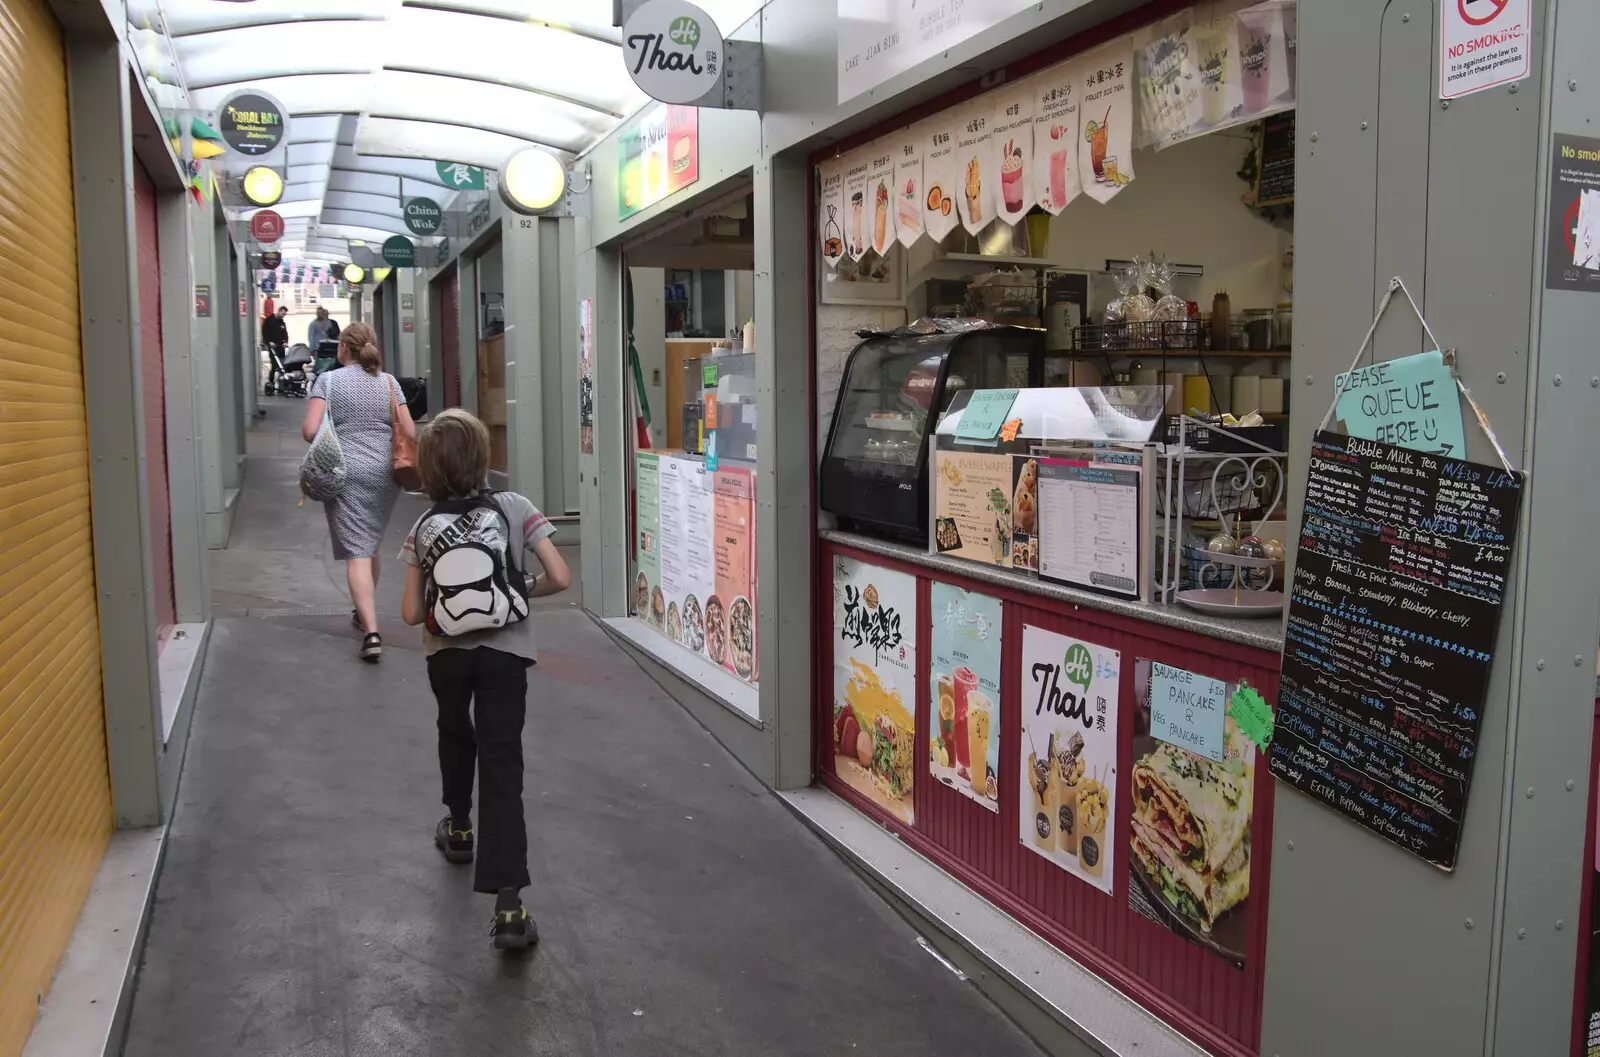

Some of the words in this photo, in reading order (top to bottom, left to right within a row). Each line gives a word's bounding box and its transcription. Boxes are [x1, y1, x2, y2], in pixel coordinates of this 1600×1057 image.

[918, 4, 946, 30] BUBBLE
[670, 20, 697, 44] Hi
[628, 33, 703, 75] Thai
[845, 54, 860, 72] CAKE
[865, 44, 881, 61] JIAN
[883, 31, 900, 50] BING
[1243, 49, 1268, 67] shmoo
[1448, 43, 1465, 60] NO
[1451, 64, 1457, 72] It
[1457, 62, 1463, 71] is
[1463, 55, 1486, 71] against
[1487, 52, 1498, 63] the
[1498, 49, 1510, 59] law
[1510, 46, 1519, 55] to
[1086, 62, 1124, 88] 水果冰茶
[1447, 71, 1467, 83] smoke
[1467, 68, 1475, 77] in
[1474, 63, 1492, 75] these
[1492, 54, 1523, 70] premises
[1042, 84, 1072, 103] 水果冰沙
[1085, 91, 1103, 102] FRUIT
[1103, 87, 1113, 97] ICE
[1113, 83, 1125, 94] TEA
[1035, 113, 1052, 123] FRUIT
[1051, 105, 1076, 119] SMOOTHIE
[1042, 102, 1059, 112] FRESH
[1060, 98, 1069, 107] ICE
[231, 111, 260, 124] CORAL
[261, 111, 279, 125] BAY
[993, 125, 1009, 134] FRESH
[1562, 145, 1575, 159] No
[407, 204, 440, 216] China
[410, 218, 436, 229] Wok
[519, 219, 532, 229] 92
[1361, 380, 1440, 418] QUEUE
[1376, 421, 1419, 446] HERE
[1346, 436, 1383, 458] Bubble
[1387, 448, 1414, 465] Milk
[1421, 456, 1437, 469] Tea
[1040, 466, 1056, 476] MENU
[421, 519, 440, 541] STAR
[422, 521, 447, 547] WARS
[461, 512, 482, 542] TROOPER
[1397, 529, 1411, 541] Ice
[1330, 559, 1353, 576] Fresh
[1355, 567, 1368, 580] Ice
[1369, 571, 1388, 585] Fruit
[1390, 576, 1429, 598] Smoothies
[1322, 614, 1348, 633] Bubble
[1350, 624, 1380, 643] Waffles
[1065, 647, 1090, 683] Hi
[1154, 663, 1193, 685] SAUSAGE
[1031, 662, 1094, 730] Thai
[1168, 686, 1216, 711] PANCAKE
[1152, 709, 1166, 725] VEG
[1185, 708, 1194, 725] &
[1280, 692, 1302, 711] Bubble
[1323, 716, 1337, 729] Tea
[1348, 729, 1361, 741] Ice
[1382, 745, 1397, 759] Tea
[1169, 722, 1205, 746] PANCAKE
[1309, 779, 1336, 803] EXTRA
[1416, 778, 1444, 801] Cherry.
